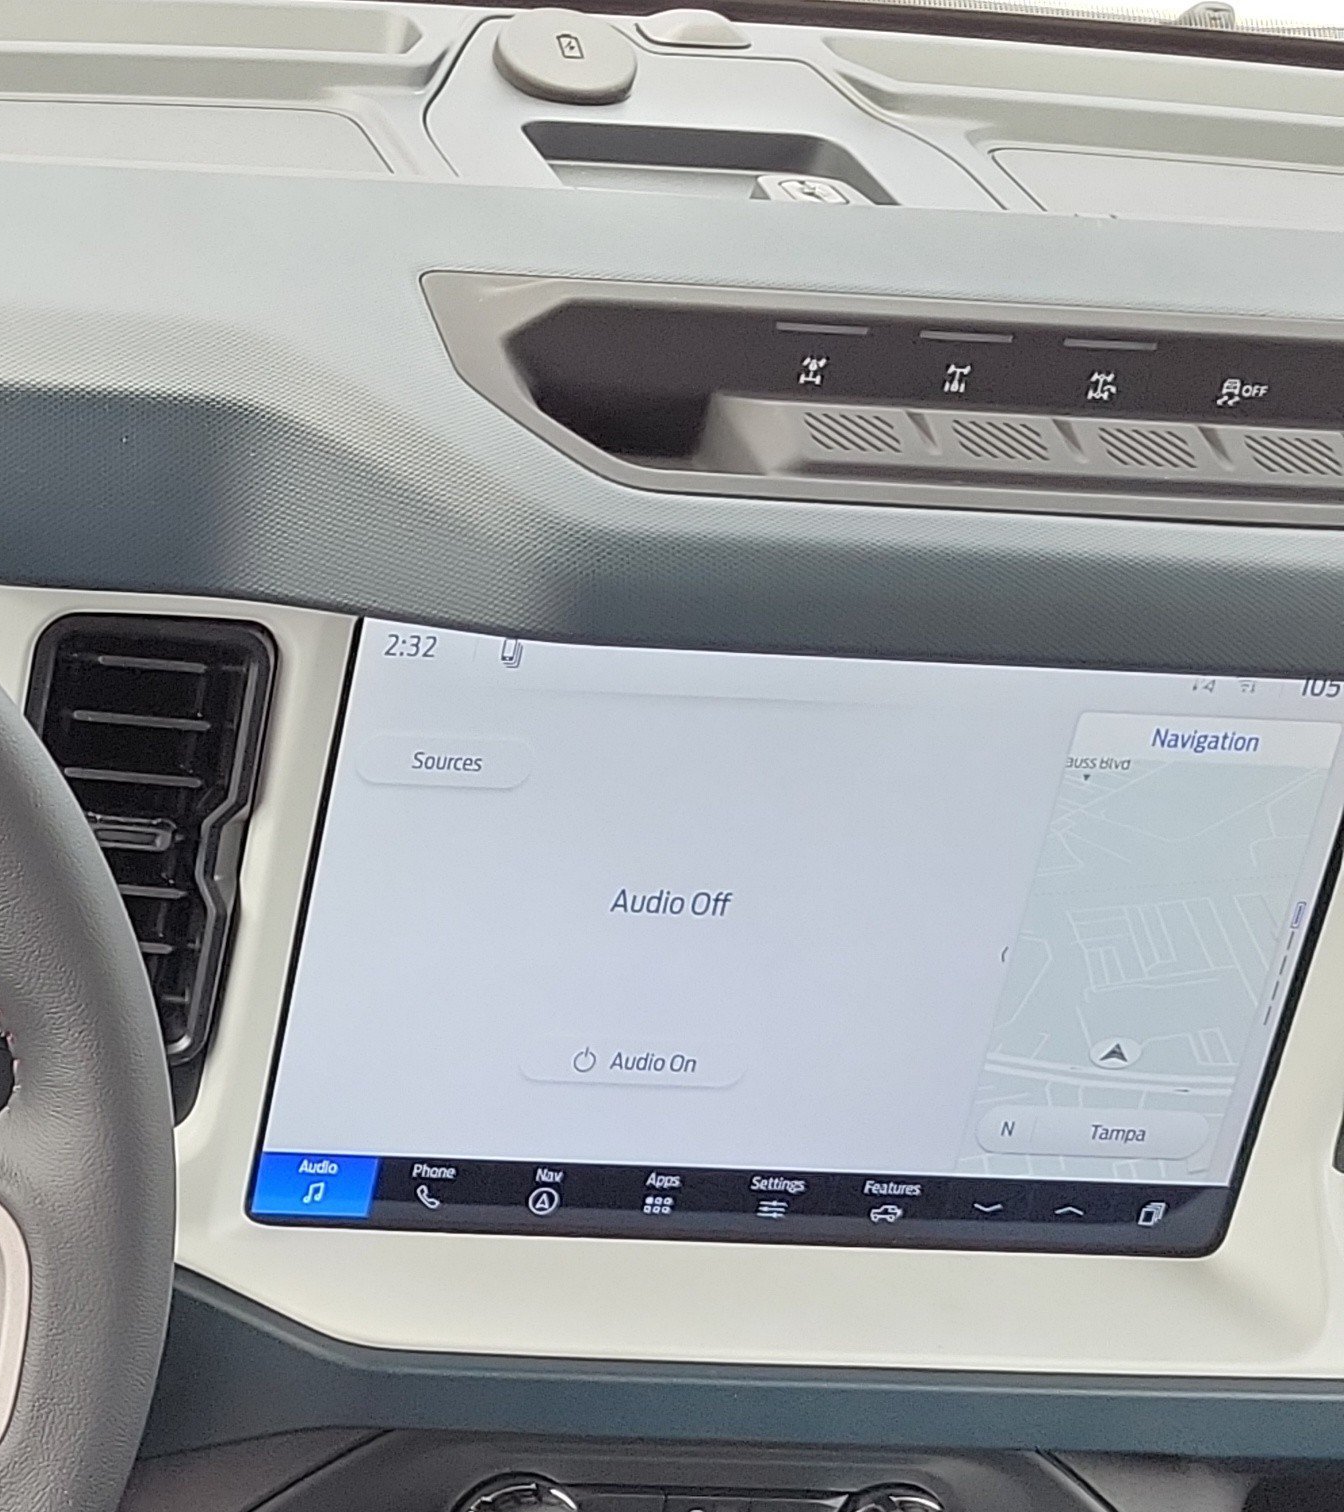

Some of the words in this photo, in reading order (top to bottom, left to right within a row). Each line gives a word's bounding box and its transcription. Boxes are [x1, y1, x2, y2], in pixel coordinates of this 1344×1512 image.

[1242, 384, 1269, 397] OFF
[383, 633, 439, 659] 2:32
[1151, 728, 1260, 754] Navigation
[411, 750, 483, 773] Sources
[610, 889, 684, 917] Audio
[690, 891, 732, 918] Off
[610, 1051, 665, 1074] Audio
[669, 1053, 698, 1074] On
[1000, 1121, 1015, 1137] N
[1090, 1124, 1147, 1144] Tampa
[298, 1158, 339, 1175] Audio
[412, 1163, 457, 1179] Phone
[536, 1168, 564, 1183] Nav
[646, 1171, 681, 1190] Apps
[750, 1175, 806, 1195] Settings
[863, 1179, 921, 1197] Features
